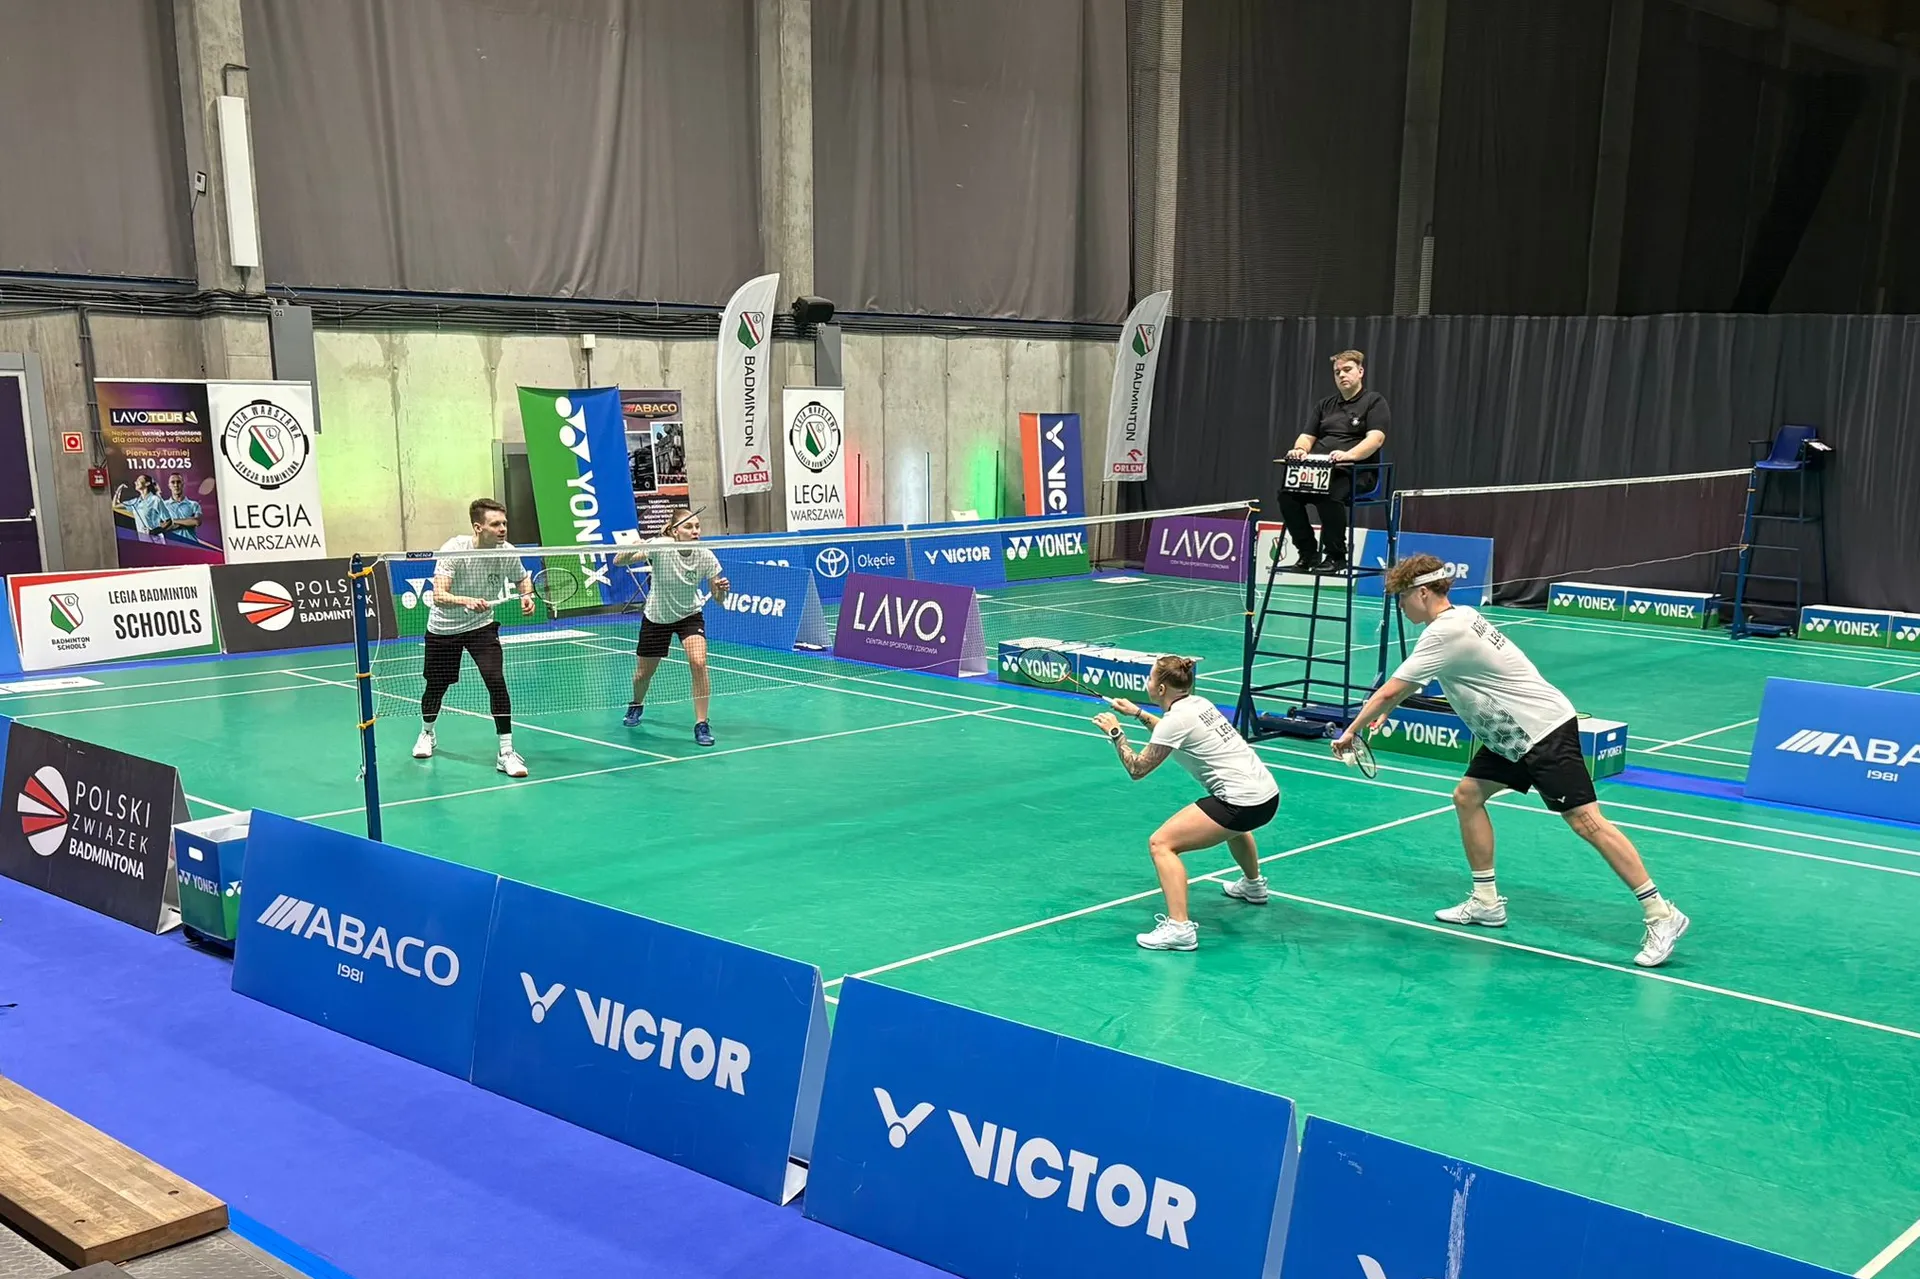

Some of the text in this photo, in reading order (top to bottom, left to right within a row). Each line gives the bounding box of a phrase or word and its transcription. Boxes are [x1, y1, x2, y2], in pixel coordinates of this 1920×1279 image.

[634, 403, 677, 413] ABACO
[744, 356, 756, 447] BADMINTON
[228, 406, 301, 439] LEGIA WARSZAWA
[125, 449, 190, 458] Pierwszy Turniej
[126, 458, 192, 470] 11.10.2025
[1114, 463, 1142, 473] ORLEN
[735, 473, 767, 484] ORLEN
[1047, 456, 1068, 514] VIC
[1287, 468, 1299, 486] 5
[1316, 470, 1329, 489] 12
[794, 484, 840, 504] LEGIA
[233, 503, 312, 529] LEGIA
[790, 508, 845, 522] WARSZAWA
[566, 470, 612, 588] YONEX
[228, 533, 322, 551] WARSZAWA
[1035, 532, 1082, 558] YONEX
[857, 553, 896, 571] Okęcie
[941, 545, 992, 564] VICTOR
[108, 586, 198, 605] LEGIA BADMINTON
[295, 577, 370, 596] POLSI
[297, 594, 374, 610] ZWIĄZK
[1576, 595, 1617, 612] YONEX
[1653, 602, 1696, 619] YONEX
[114, 608, 202, 640] SCHOOLS
[300, 607, 377, 623] BADMINTA
[1833, 619, 1880, 638] YONEX
[51, 636, 91, 645] BADMINTON
[57, 643, 87, 651] SCHOOLS
[1026, 658, 1068, 679] YONEX
[1105, 669, 1150, 693] YONEX
[1403, 721, 1460, 749] YONEX
[1607, 745, 1623, 758] YONEX
[1866, 769, 1899, 783] 1981
[75, 780, 151, 829] POLSKI
[72, 813, 150, 855] ZWIĄZEK
[69, 838, 145, 881] BADMINTONA
[192, 874, 220, 897] YONEX
[304, 907, 460, 987] ABACO
[337, 962, 364, 984] 1981
[575, 989, 751, 1096] VICTOR
[947, 1109, 1197, 1249] VICTOR
